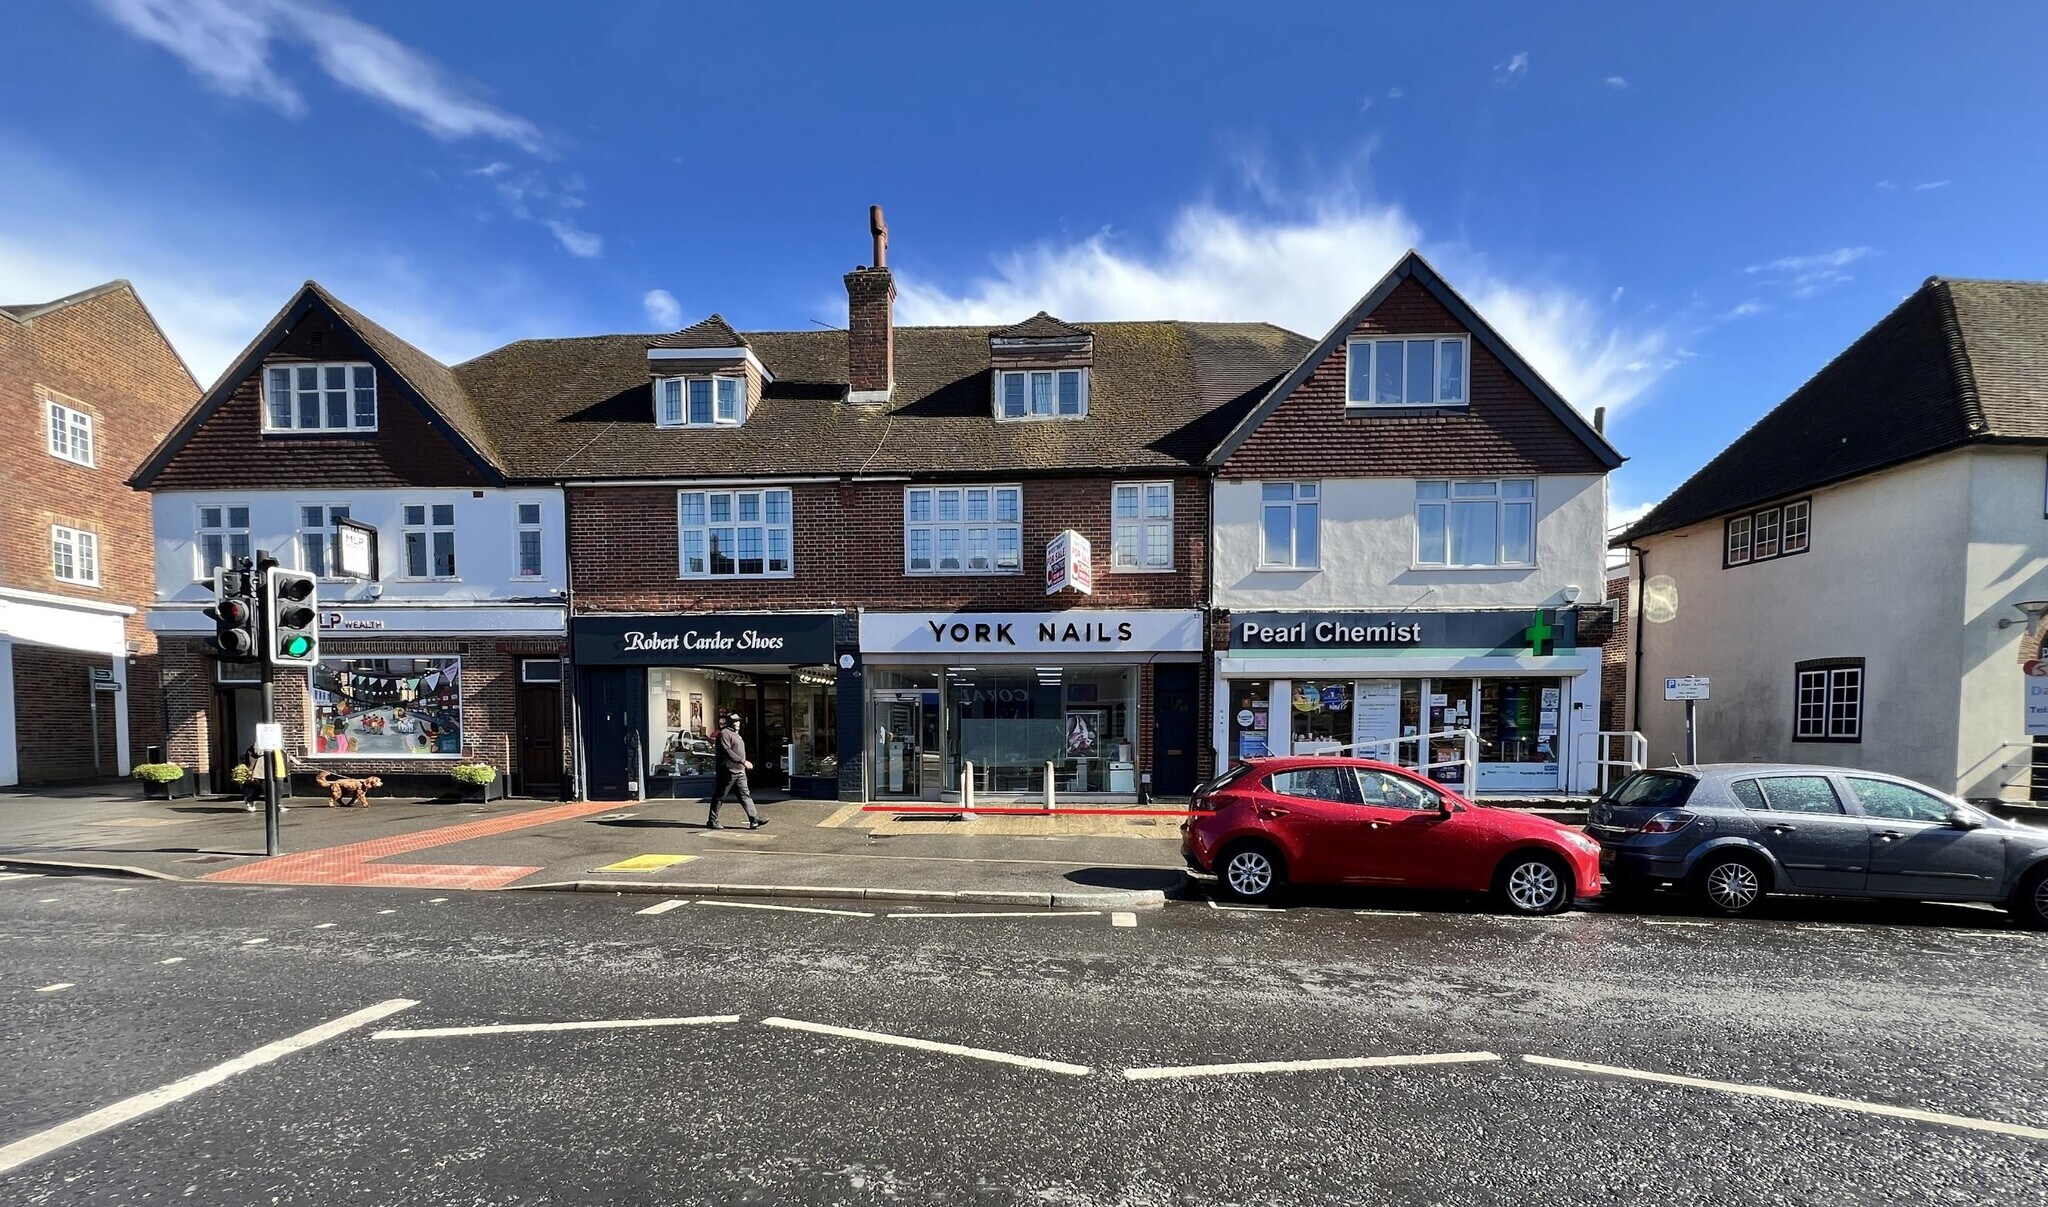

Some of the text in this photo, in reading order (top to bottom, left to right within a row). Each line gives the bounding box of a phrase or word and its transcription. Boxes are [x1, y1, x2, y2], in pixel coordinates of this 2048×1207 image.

[318, 613, 384, 629] LP WEALTH
[624, 630, 783, 650] Robert Carder Shoes
[929, 621, 1132, 645] YORK NAILS
[1243, 621, 1421, 643] Pearl Chemist
